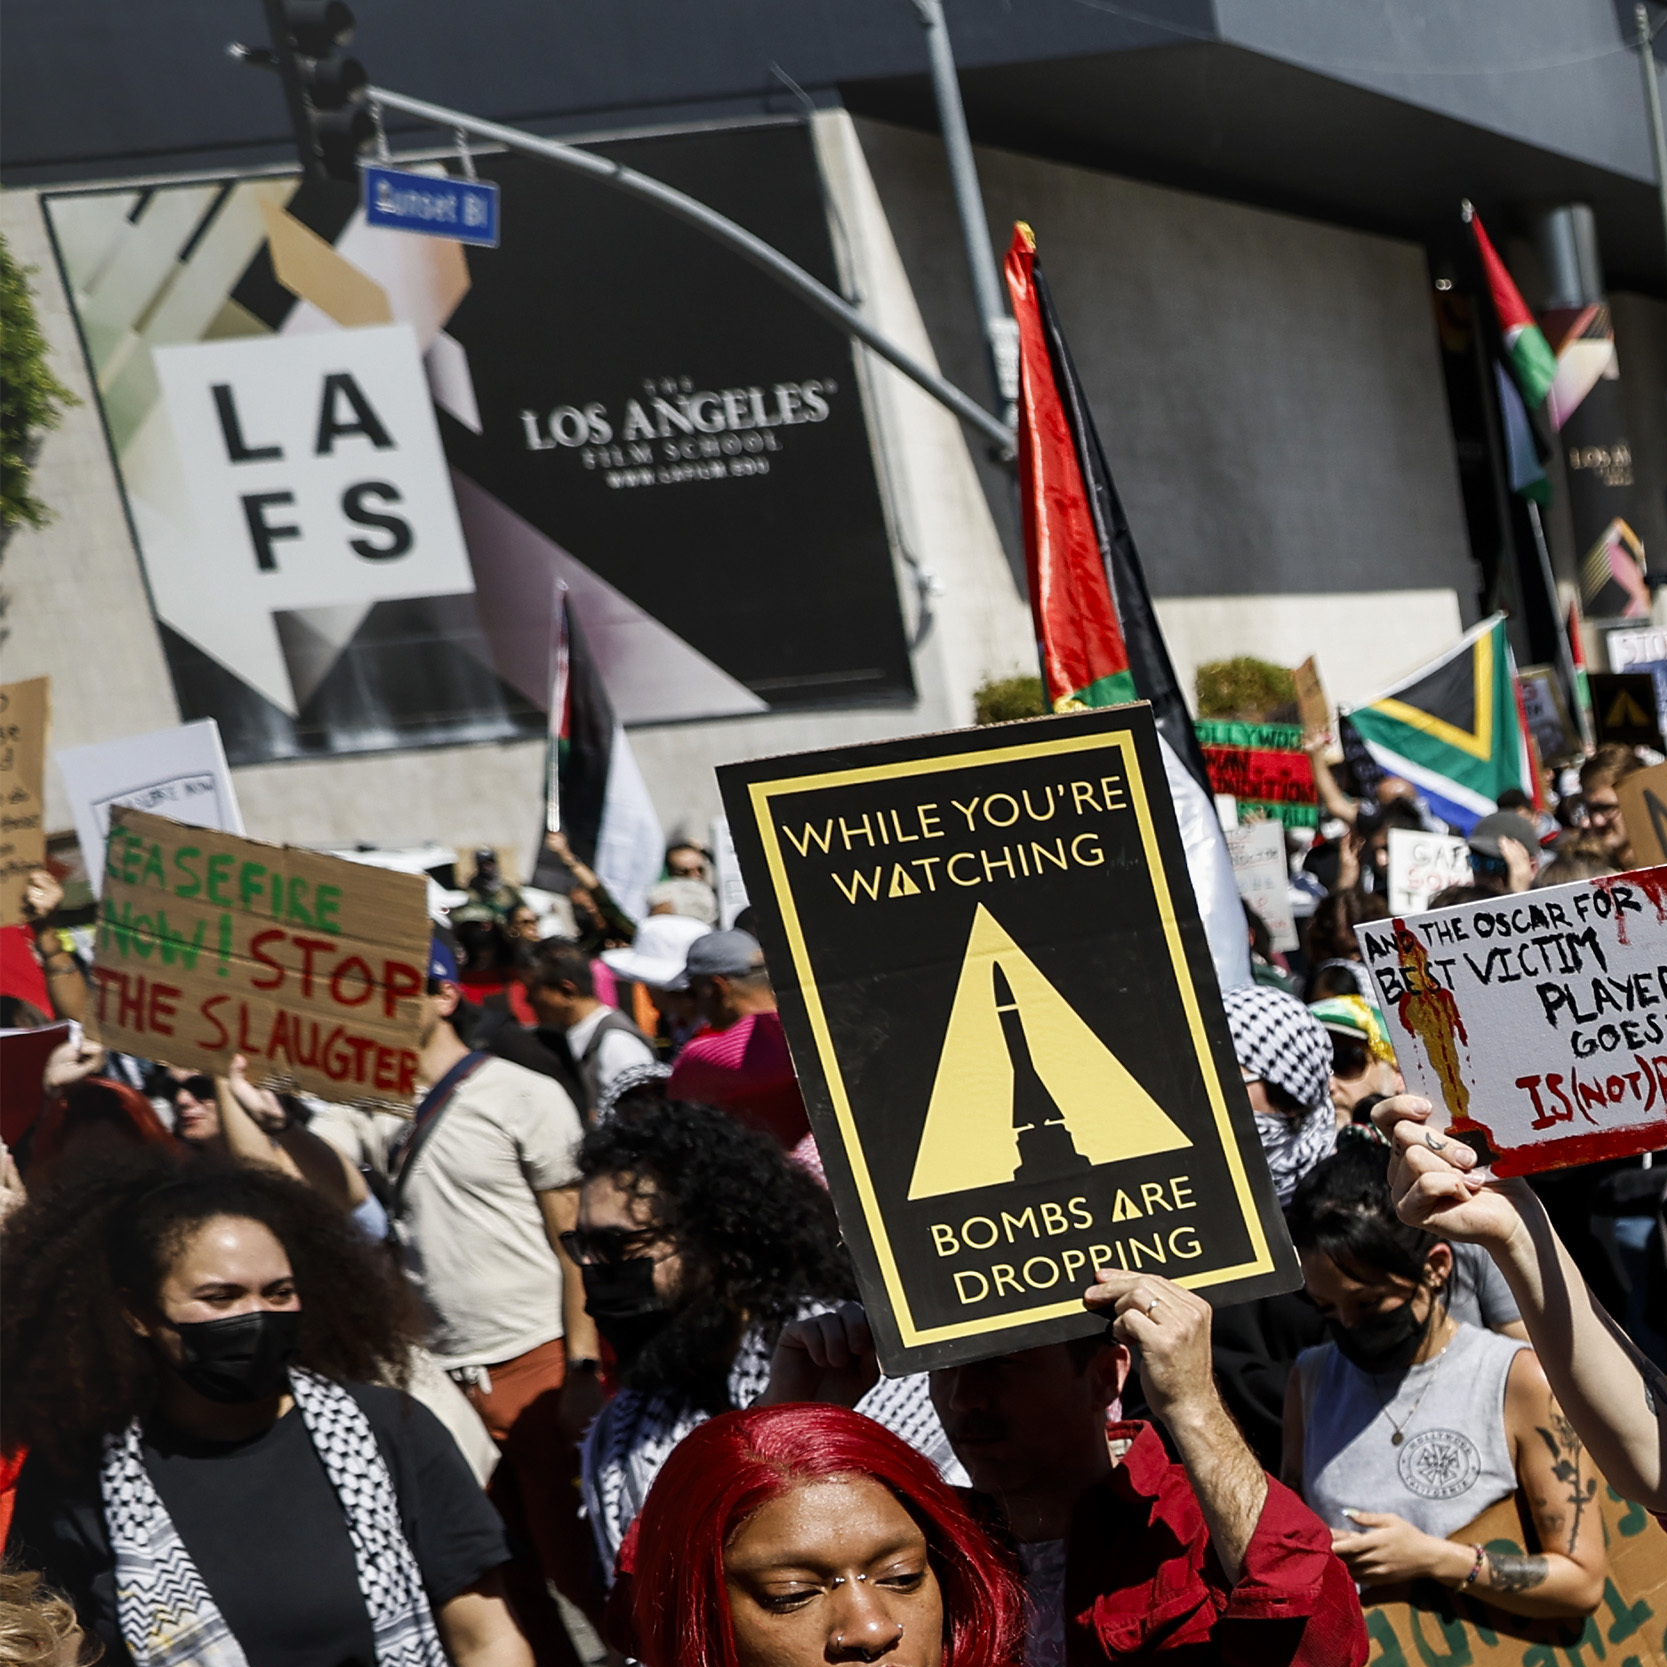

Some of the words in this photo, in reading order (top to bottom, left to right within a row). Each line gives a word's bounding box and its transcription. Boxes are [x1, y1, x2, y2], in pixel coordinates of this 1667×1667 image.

[376, 179, 458, 223] Sunset
[520, 402, 613, 450] LOS
[622, 379, 830, 441] ANGELES
[782, 803, 945, 857] WHILE
[951, 775, 1128, 832] YOU'RE
[107, 824, 344, 935] CEASEFIRE
[831, 832, 1106, 905] WATCHING
[1419, 918, 1472, 948] THE
[1473, 903, 1574, 940] OSCAR
[1572, 887, 1642, 924] FOR
[100, 897, 235, 978] NOW!
[249, 930, 425, 1019] STOP
[1375, 957, 1457, 1005] BEST
[1463, 925, 1608, 986] VICTIM
[94, 967, 184, 1038] THE
[200, 996, 420, 1095] SLAUGTER
[1570, 1013, 1664, 1059] GOES
[931, 1197, 1094, 1258] BOMBS
[1111, 1176, 1197, 1224] ARE
[953, 1226, 1203, 1305] DROPPING
